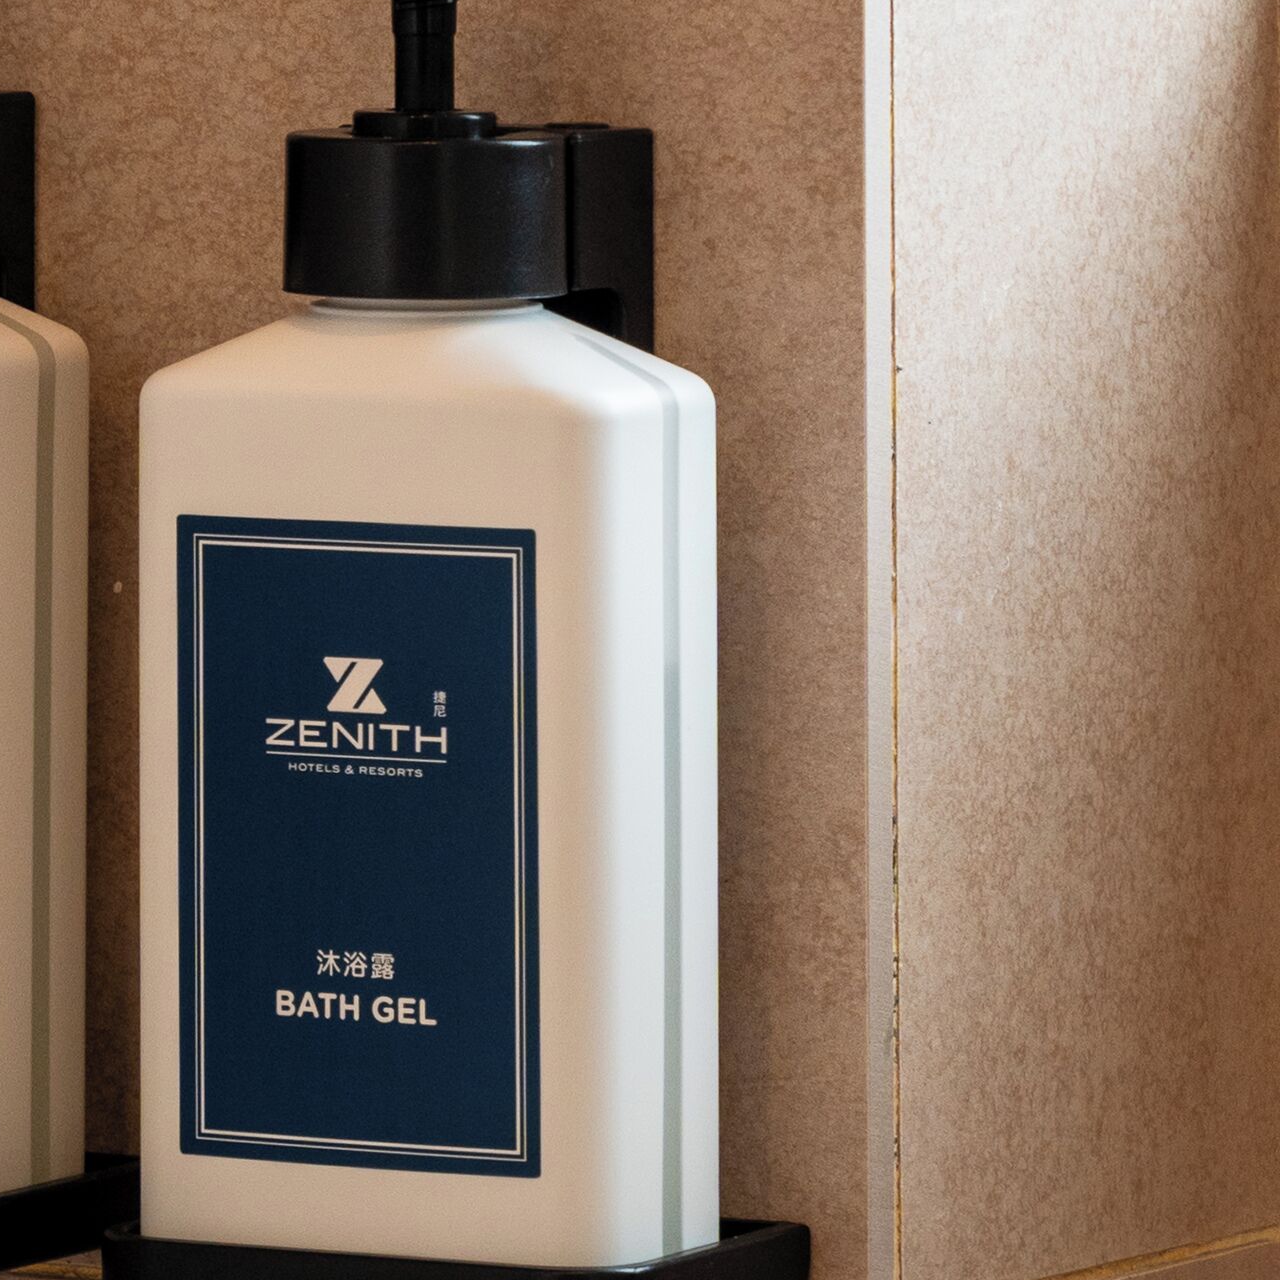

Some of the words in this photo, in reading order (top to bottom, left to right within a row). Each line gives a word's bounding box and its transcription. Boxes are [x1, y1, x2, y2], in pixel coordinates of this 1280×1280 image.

[265, 717, 448, 755] ZENITH
[288, 762, 341, 774] HOTELS
[344, 764, 355, 775] &
[358, 765, 424, 778] RESORTS
[316, 949, 395, 980] 沐浴露
[275, 989, 360, 1022] BATH
[371, 995, 438, 1026] GEL
